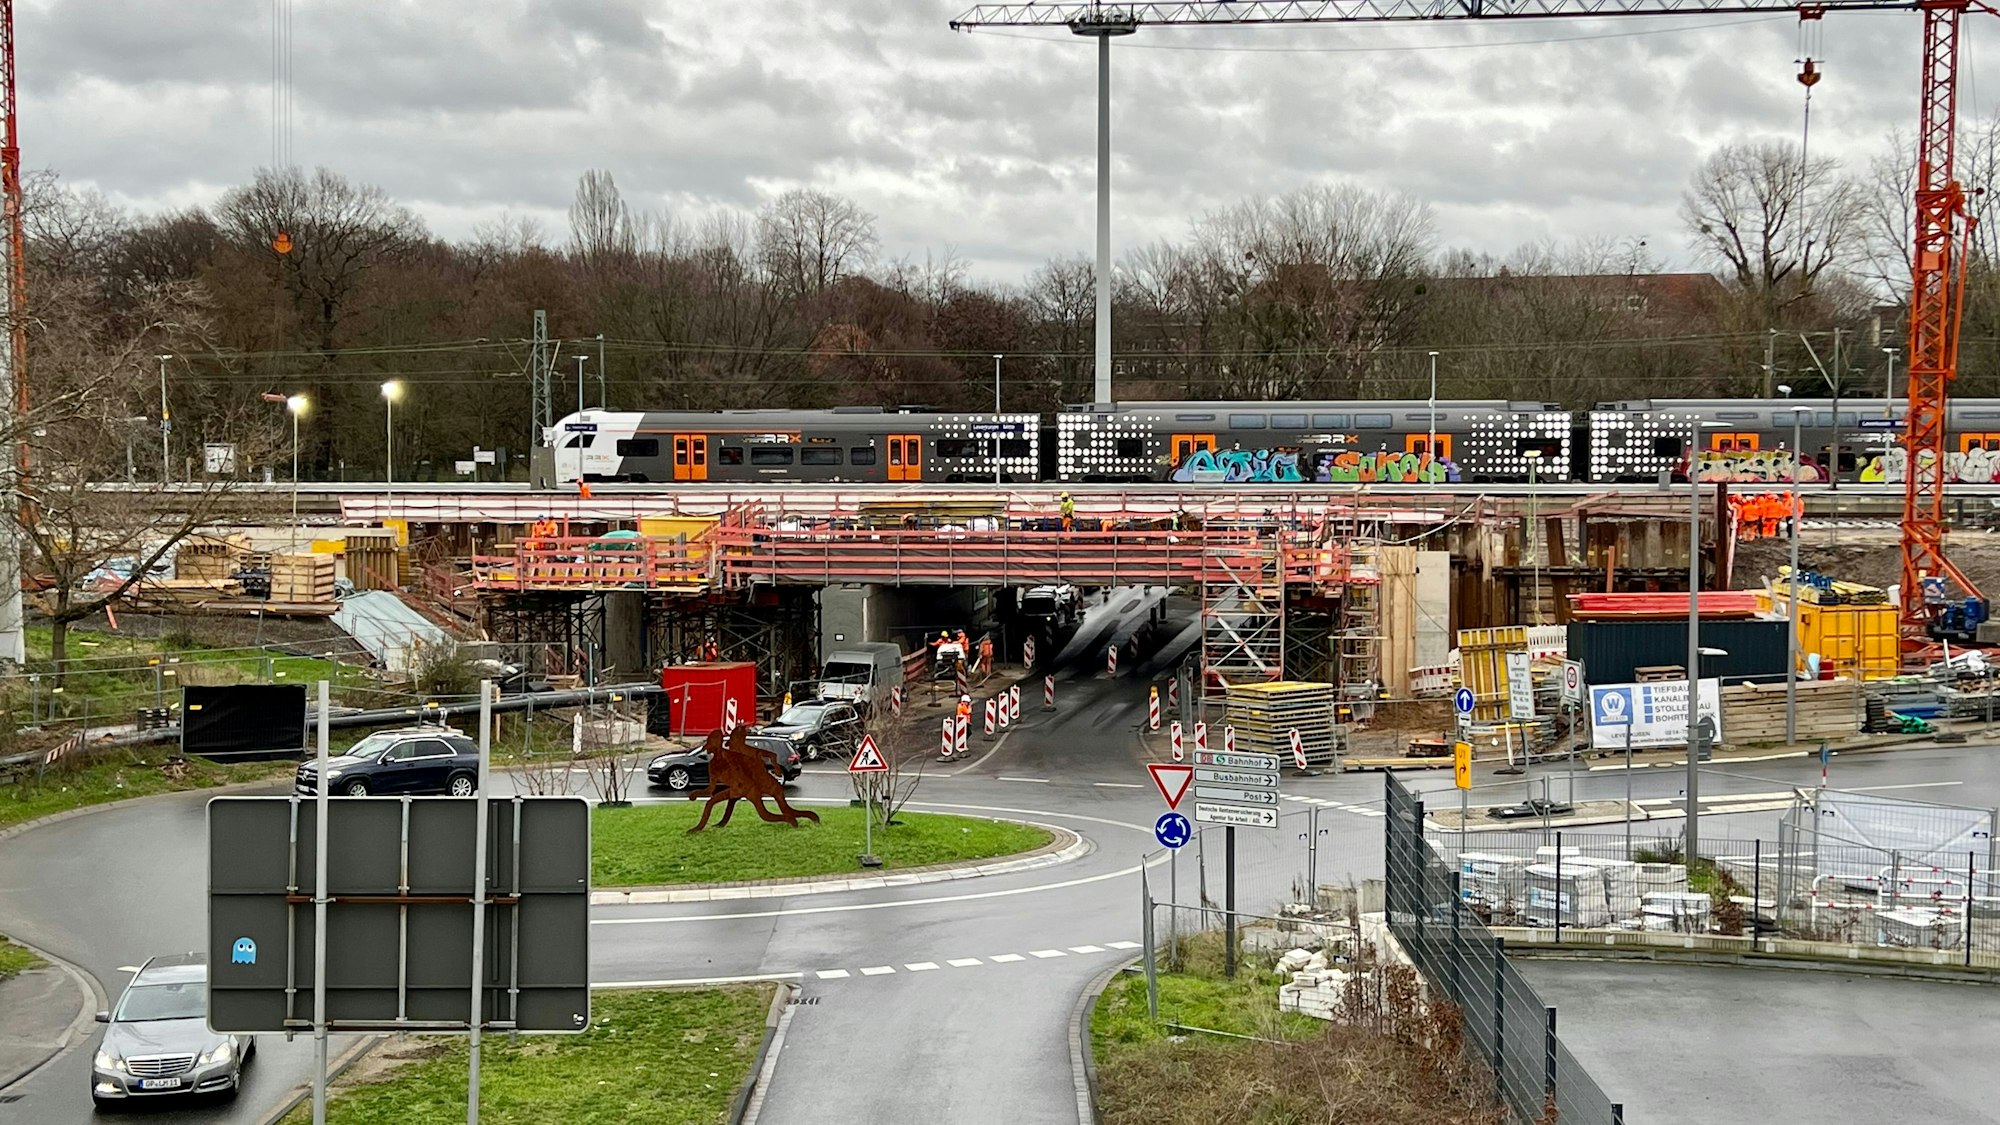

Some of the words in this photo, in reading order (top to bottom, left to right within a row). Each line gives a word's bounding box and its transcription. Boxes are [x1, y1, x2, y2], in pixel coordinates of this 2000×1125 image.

[1234, 442, 1240, 450] 2
[1380, 442, 1387, 450] 2
[1779, 441, 1785, 449] 2
[1606, 698, 1620, 709] W
[1228, 757, 1262, 766] Bahnhof
[1213, 773, 1262, 783] Busbahnhof
[1243, 792, 1262, 801] Post
